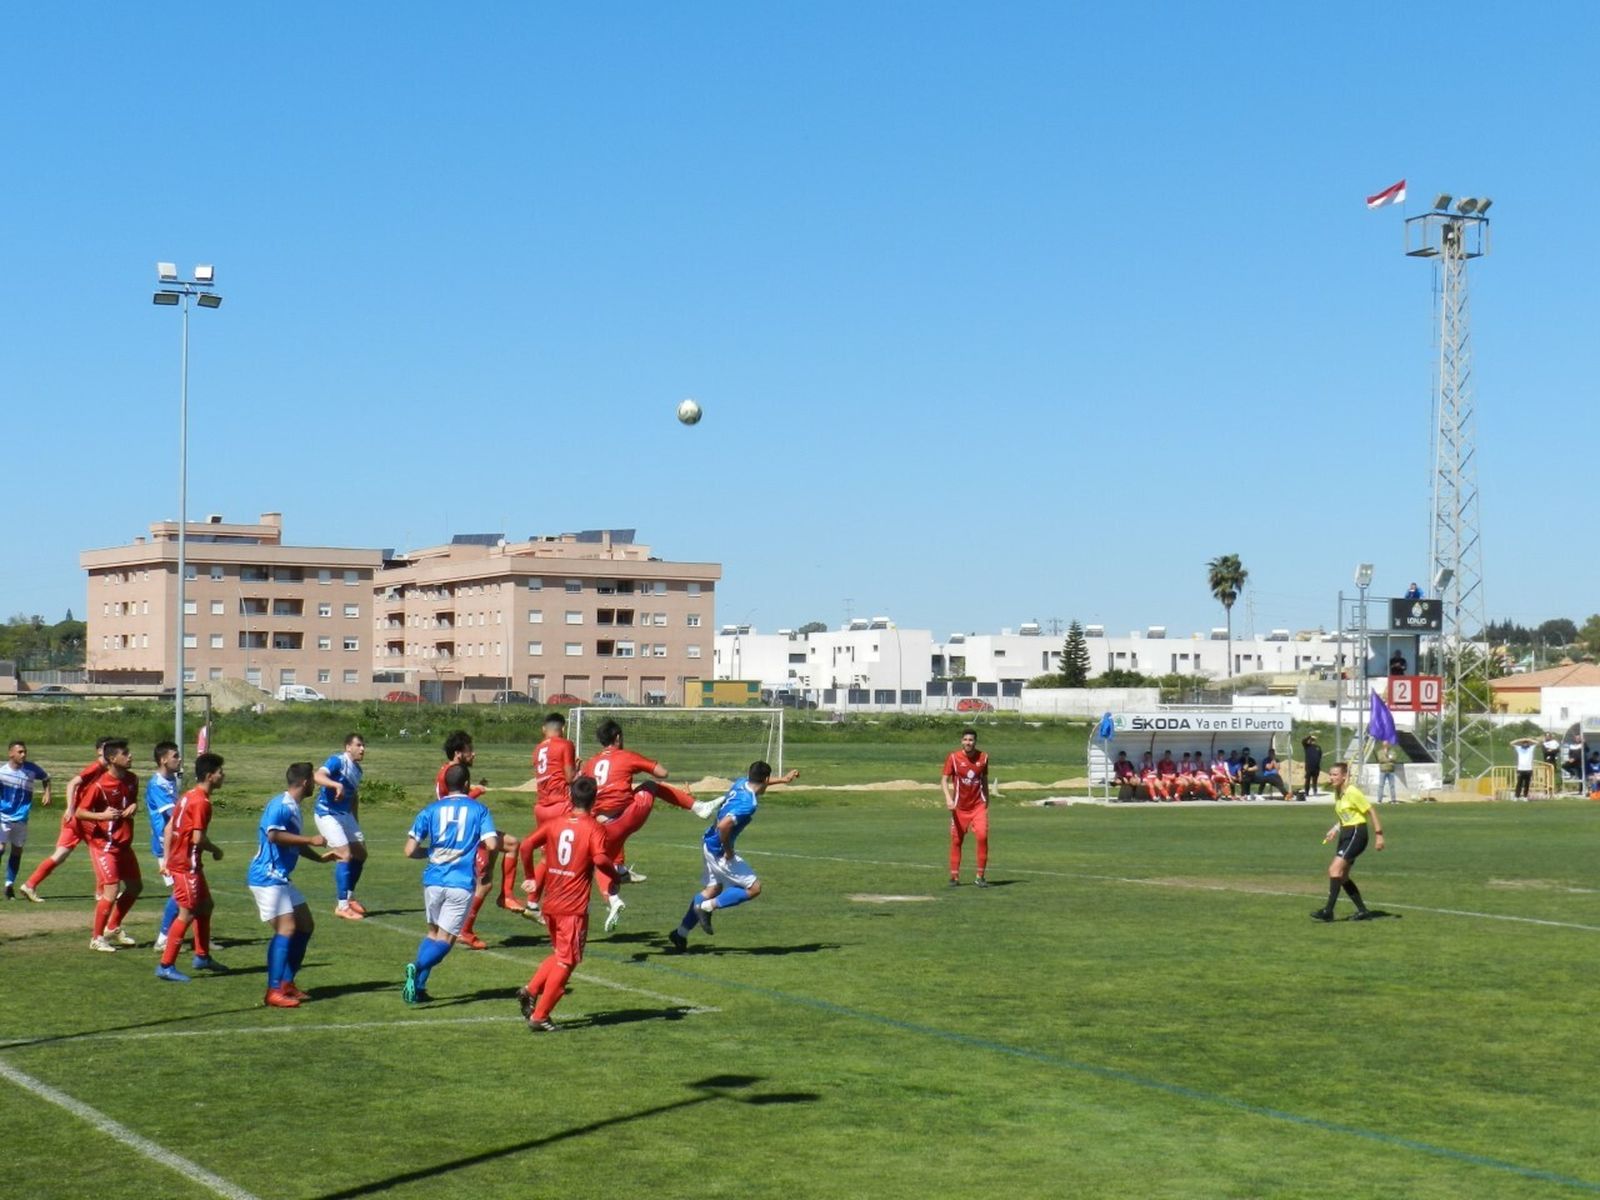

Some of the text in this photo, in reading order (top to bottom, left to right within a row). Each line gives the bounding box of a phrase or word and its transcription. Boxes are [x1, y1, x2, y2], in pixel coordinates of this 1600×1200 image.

[1398, 682, 1434, 699] 2 0
[1132, 715, 1285, 730] ŠKODA Ya en El Puerto
[537, 747, 548, 775] 5
[594, 759, 610, 786] 9
[438, 806, 468, 842] 14
[558, 828, 575, 866] 6
